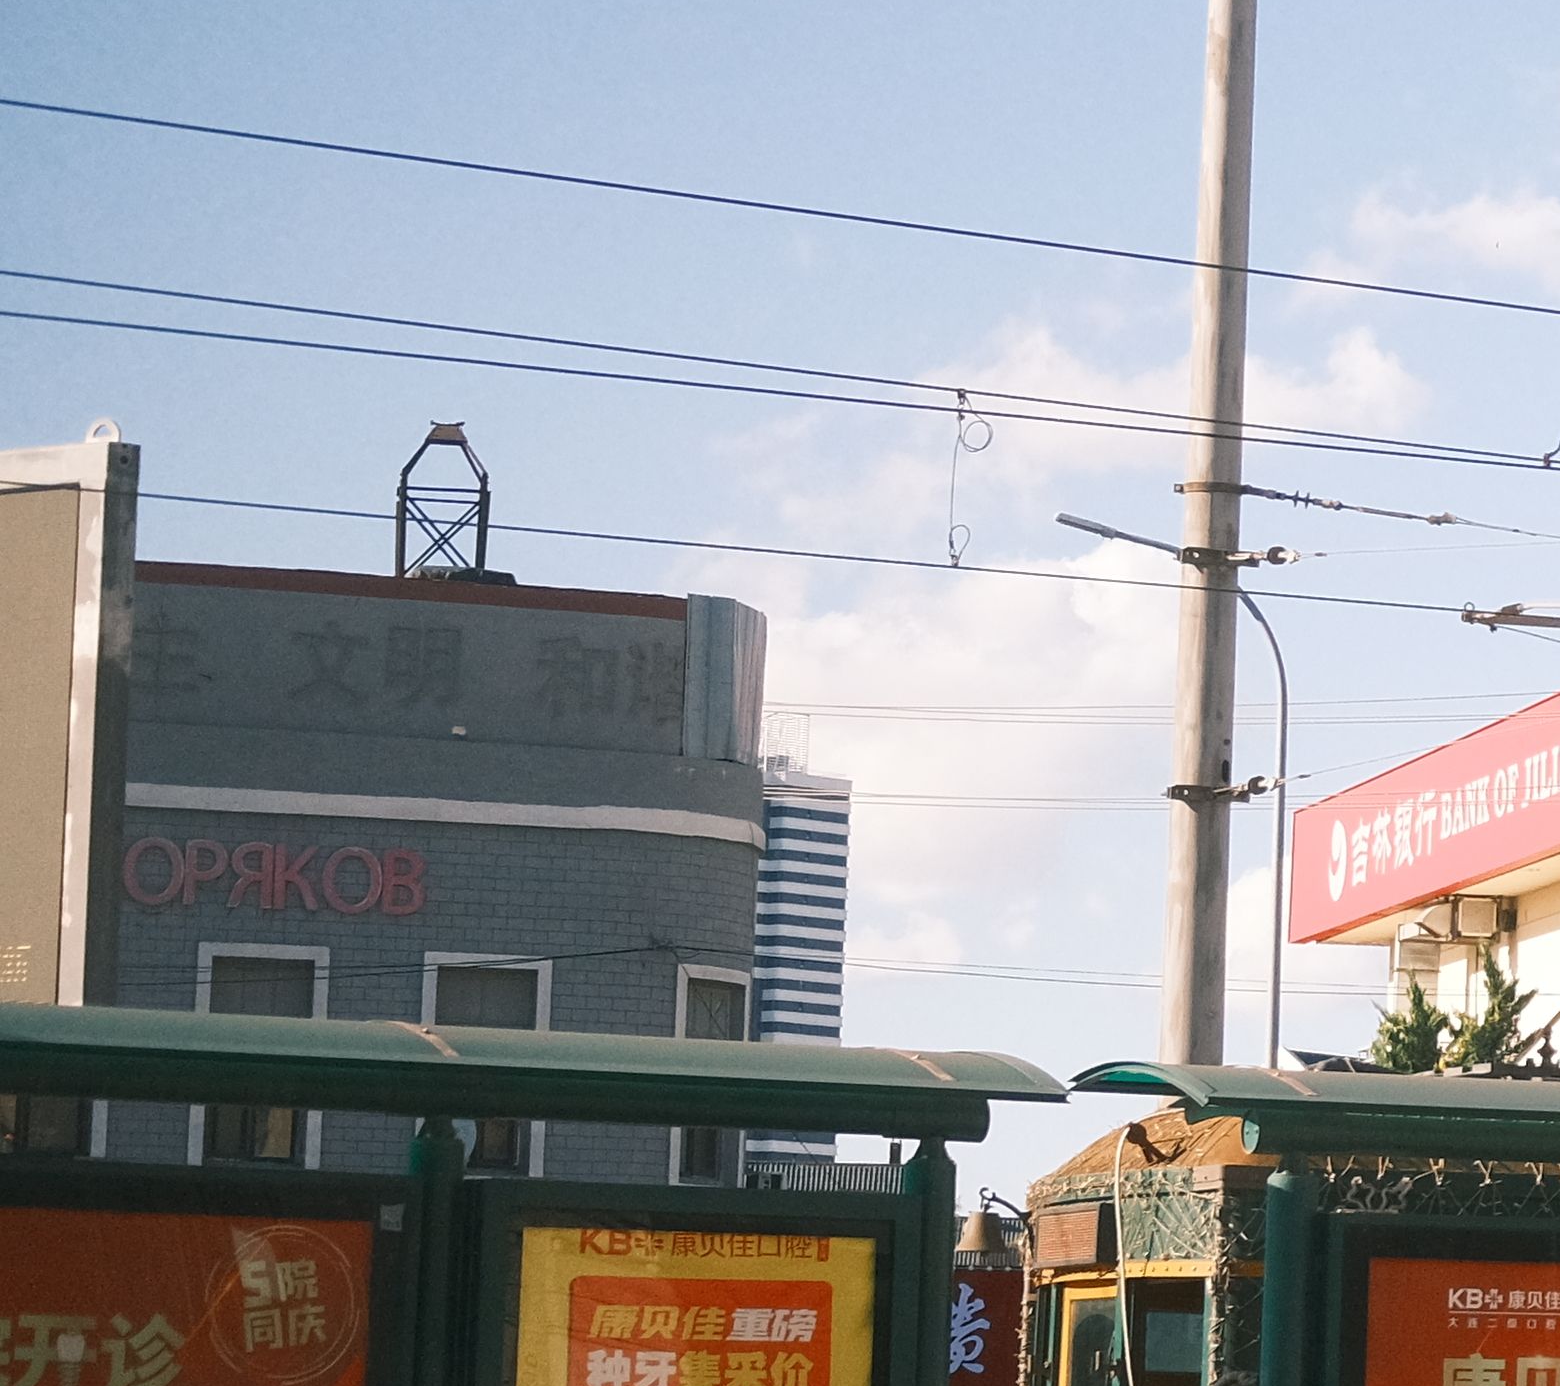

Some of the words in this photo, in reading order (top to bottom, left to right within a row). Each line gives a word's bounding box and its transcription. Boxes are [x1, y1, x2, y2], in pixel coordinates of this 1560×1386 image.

[1351, 789, 1438, 888] 吉林银行
[1440, 775, 1490, 841] BANK
[1493, 763, 1520, 819] OF
[1448, 1287, 1484, 1310] KB
[242, 1305, 327, 1354] 同庆
[588, 1303, 818, 1344] 康贝佳重磅
